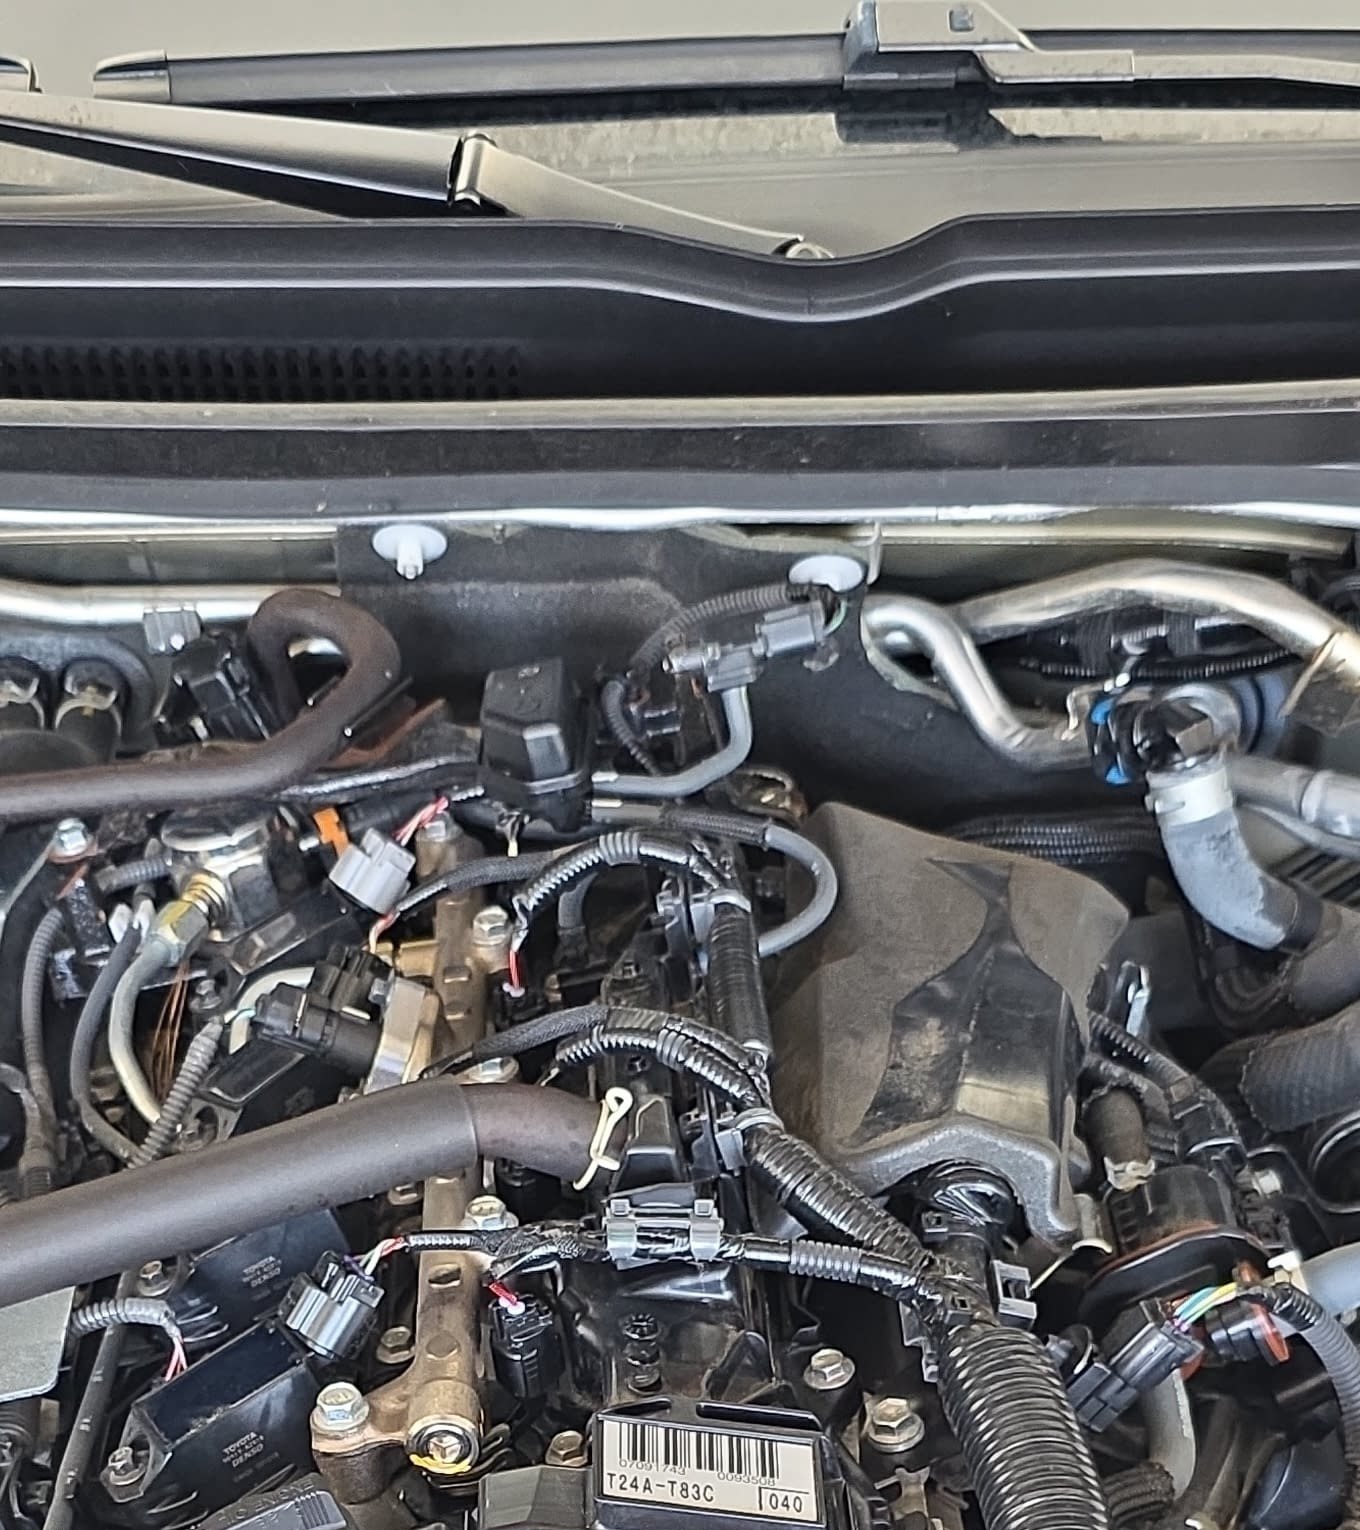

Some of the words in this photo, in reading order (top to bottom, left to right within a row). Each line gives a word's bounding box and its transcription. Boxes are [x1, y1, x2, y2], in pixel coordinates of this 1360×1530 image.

[222, 1431, 258, 1455] TOYOTA
[231, 1443, 264, 1468] DENSO
[606, 1471, 715, 1503] T24A-T83C
[768, 1492, 803, 1513] 040
